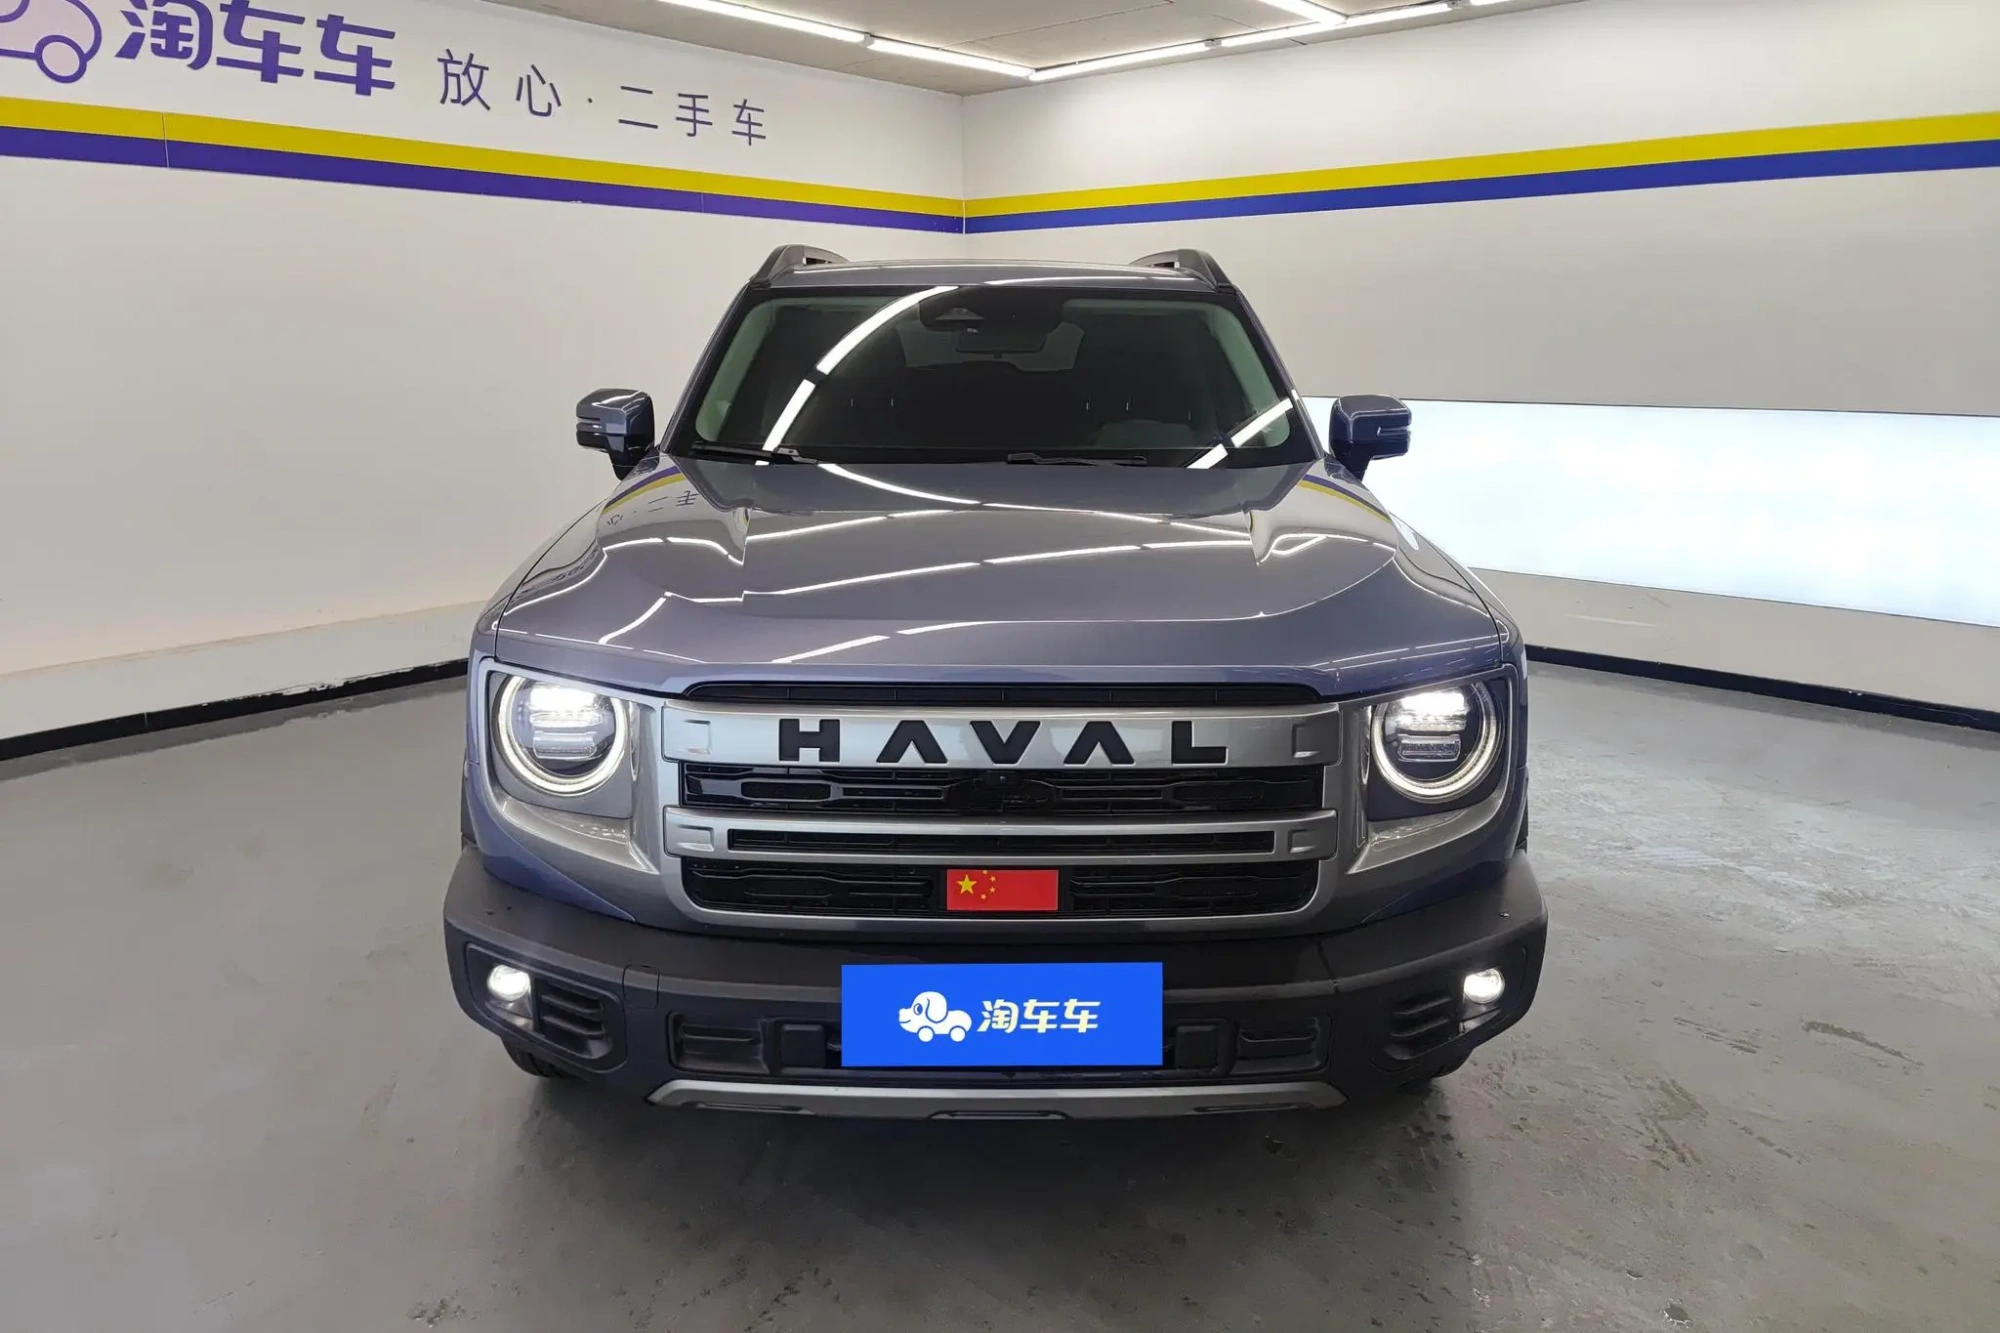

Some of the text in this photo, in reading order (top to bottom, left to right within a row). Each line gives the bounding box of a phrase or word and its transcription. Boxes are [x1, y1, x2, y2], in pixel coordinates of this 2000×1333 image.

[114, 0, 395, 96] 淘车车
[778, 718, 1227, 765] HAVAL
